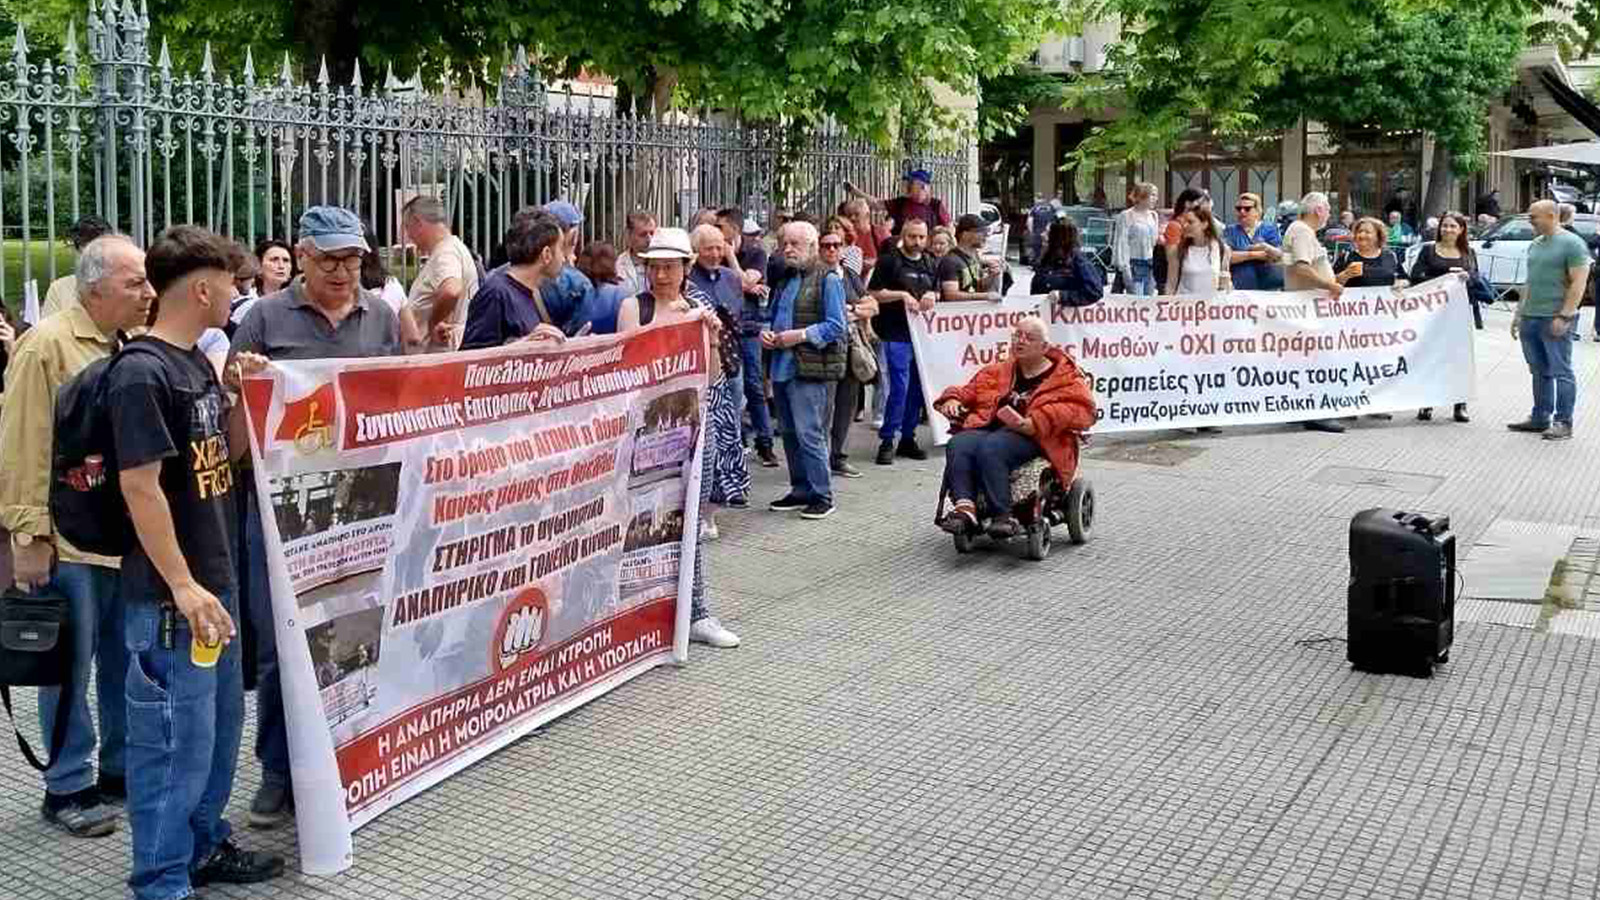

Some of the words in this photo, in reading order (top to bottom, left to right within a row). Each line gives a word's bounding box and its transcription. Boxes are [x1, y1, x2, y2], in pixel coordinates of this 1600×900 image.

[1051, 300, 1149, 328] Κλαδικής
[1155, 300, 1258, 326] Σύμβασης
[1313, 292, 1369, 318] Ειδική
[961, 339, 1077, 367] Αυξς
[1082, 335, 1159, 359] Μισθών
[1180, 331, 1215, 356] ΟΧΙ
[1223, 337, 1256, 354] στα
[1261, 331, 1333, 357] Ωράρια
[1337, 326, 1417, 351] Λάστιχο
[1194, 373, 1225, 394] για
[1231, 366, 1300, 389] Όλους
[1306, 367, 1348, 386] τους
[1352, 355, 1408, 386] ΑμεΑ
[1109, 400, 1219, 426] Εργαζομένων
[1223, 399, 1260, 415] στην
[1265, 395, 1315, 412] Ειδική
[1319, 390, 1371, 411] Αγωγή
[424, 457, 453, 484] Στο
[509, 438, 535, 463] του
[535, 424, 580, 456] ΑΓΩΝΑ
[432, 526, 516, 572] ΣΤΗΡΙΓΜΑ
[520, 524, 534, 545] το
[392, 570, 498, 626] ΑΝΑΠΗΡΙΚΟ
[500, 565, 526, 590] και
[342, 764, 386, 804] ΟΠΗ
[391, 738, 435, 779] ΕΙΝΑΙ
[438, 729, 452, 754] Η
[455, 682, 555, 745] ΜΟΙΡΟΛΑΤΡΙΑ
[557, 664, 583, 694] ΚΑΙ
[584, 657, 596, 676] Η
[598, 629, 661, 676] ΥΠΟΤΑΓΗ!
[378, 733, 391, 757] Η
[396, 694, 483, 748] ΑΝΑΠΗΡΙΑ
[484, 674, 516, 709] ΔΕΝ
[519, 656, 555, 689] ΕΙΝΑΙ
[557, 628, 612, 669] ΝΤΡΟΠΗ
